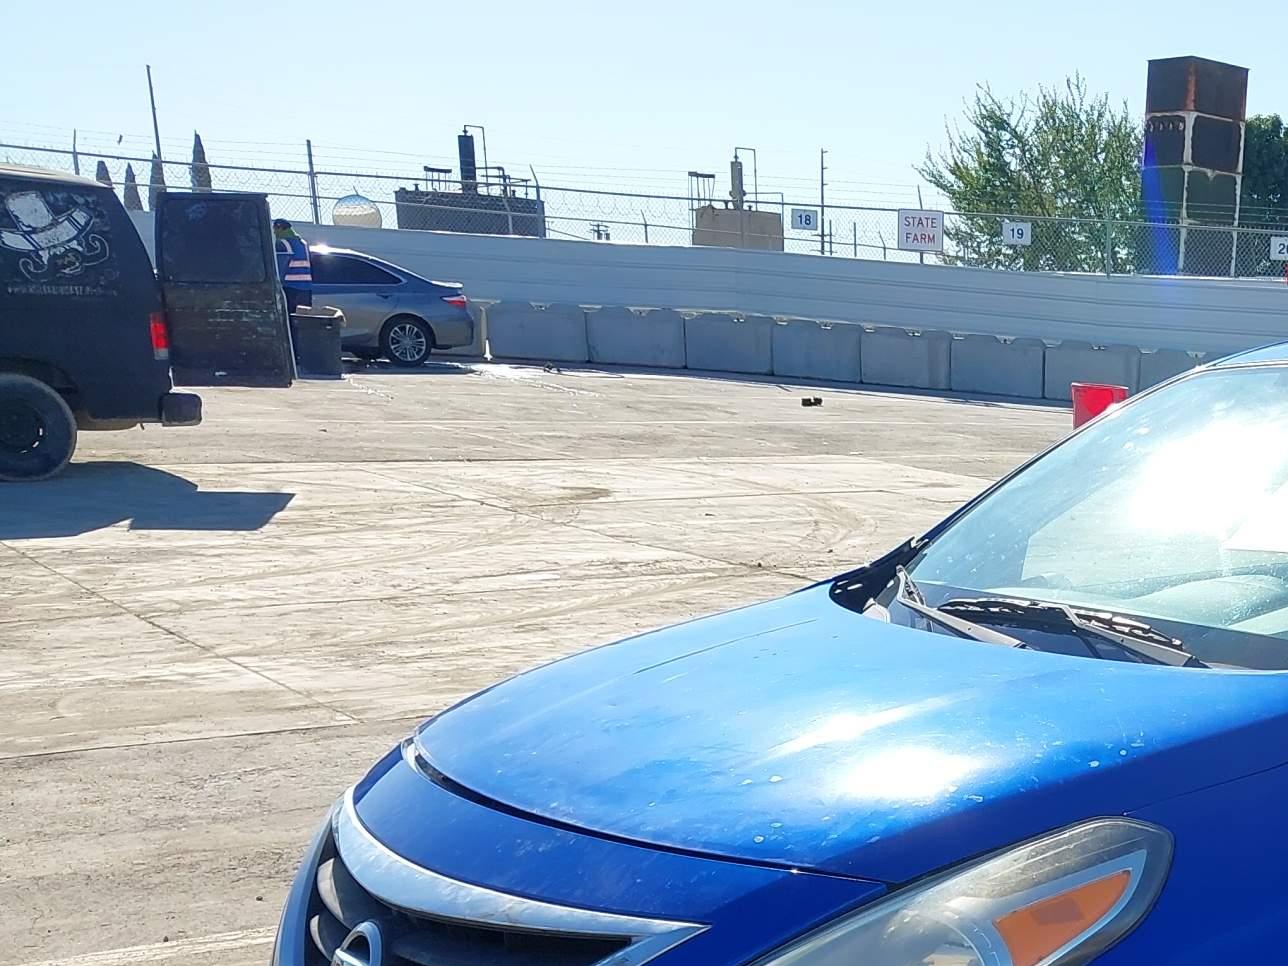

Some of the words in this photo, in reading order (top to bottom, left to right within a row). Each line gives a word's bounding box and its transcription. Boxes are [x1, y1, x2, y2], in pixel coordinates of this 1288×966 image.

[797, 214, 812, 226] 18
[904, 216, 938, 229] STATE
[905, 232, 936, 245] FARM
[1009, 227, 1025, 240] 19
